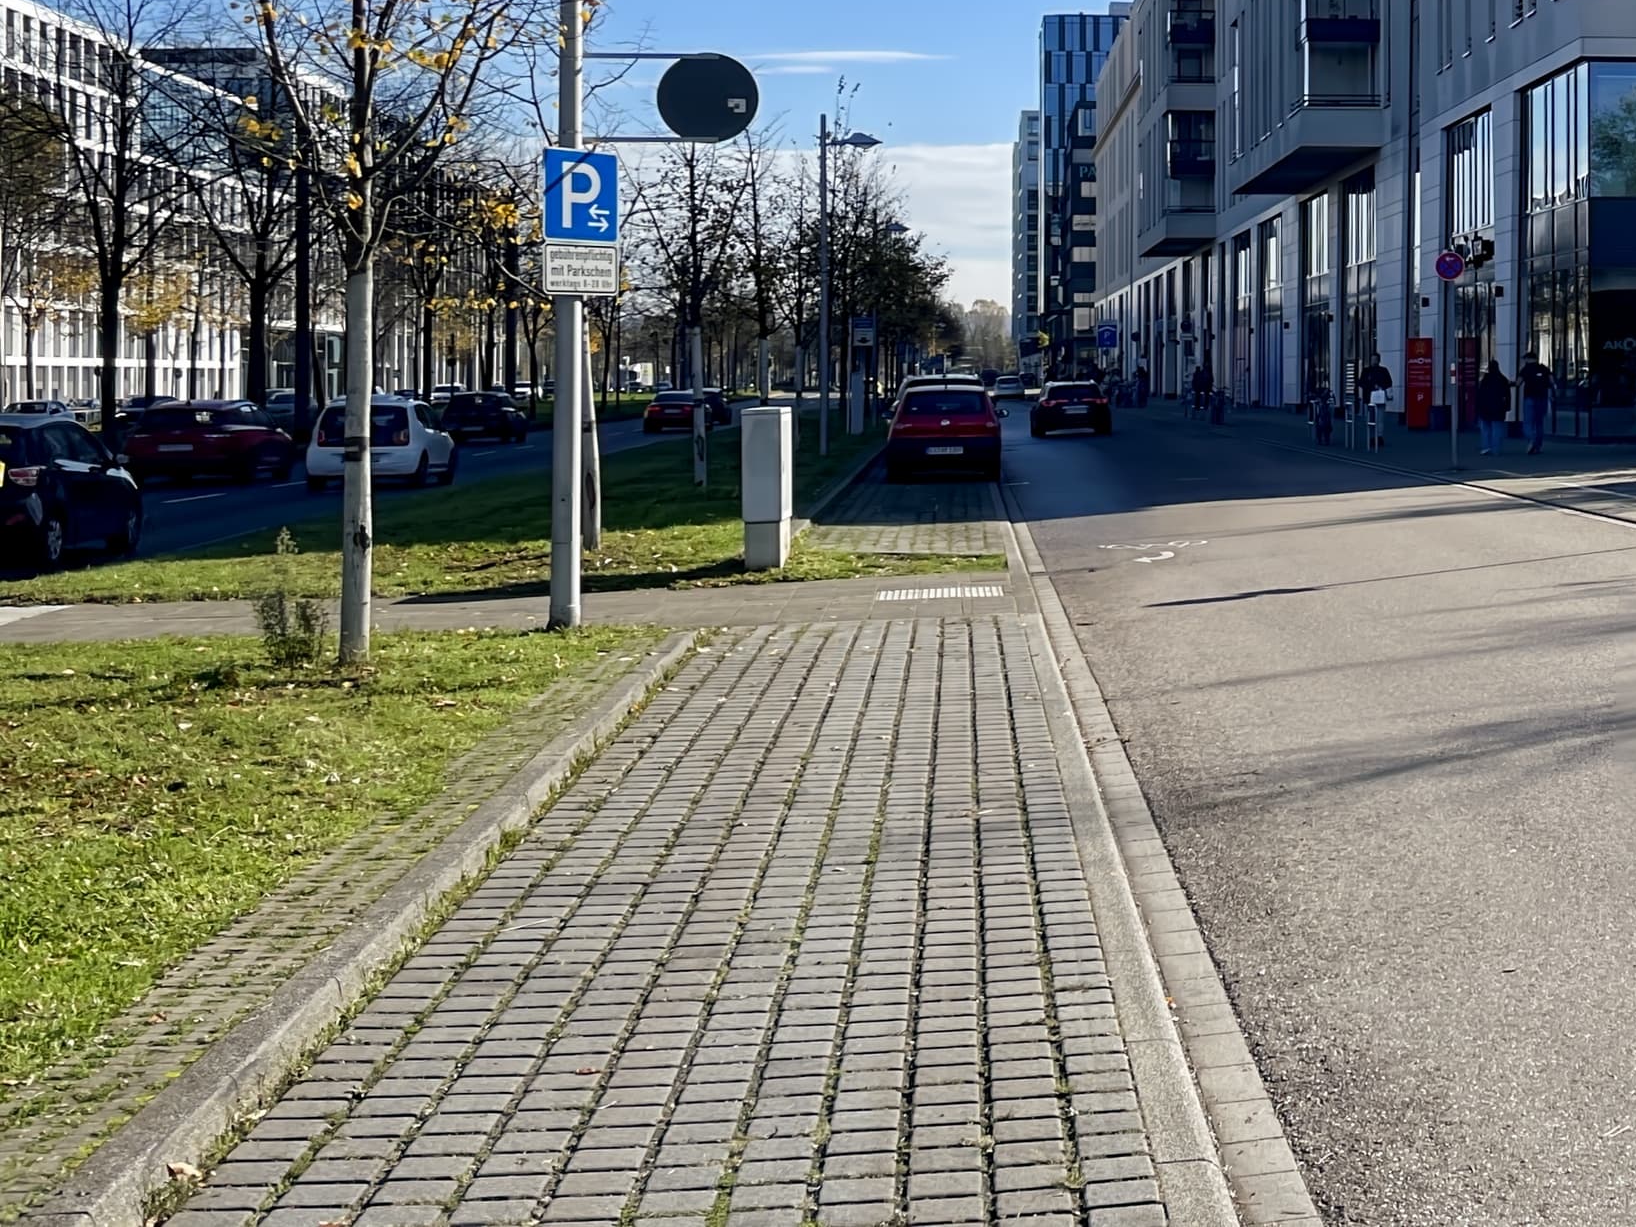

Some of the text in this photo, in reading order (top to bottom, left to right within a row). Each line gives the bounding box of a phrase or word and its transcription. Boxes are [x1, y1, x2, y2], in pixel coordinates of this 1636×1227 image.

[561, 161, 602, 228] P
[551, 264, 612, 277] mit Parkschein
